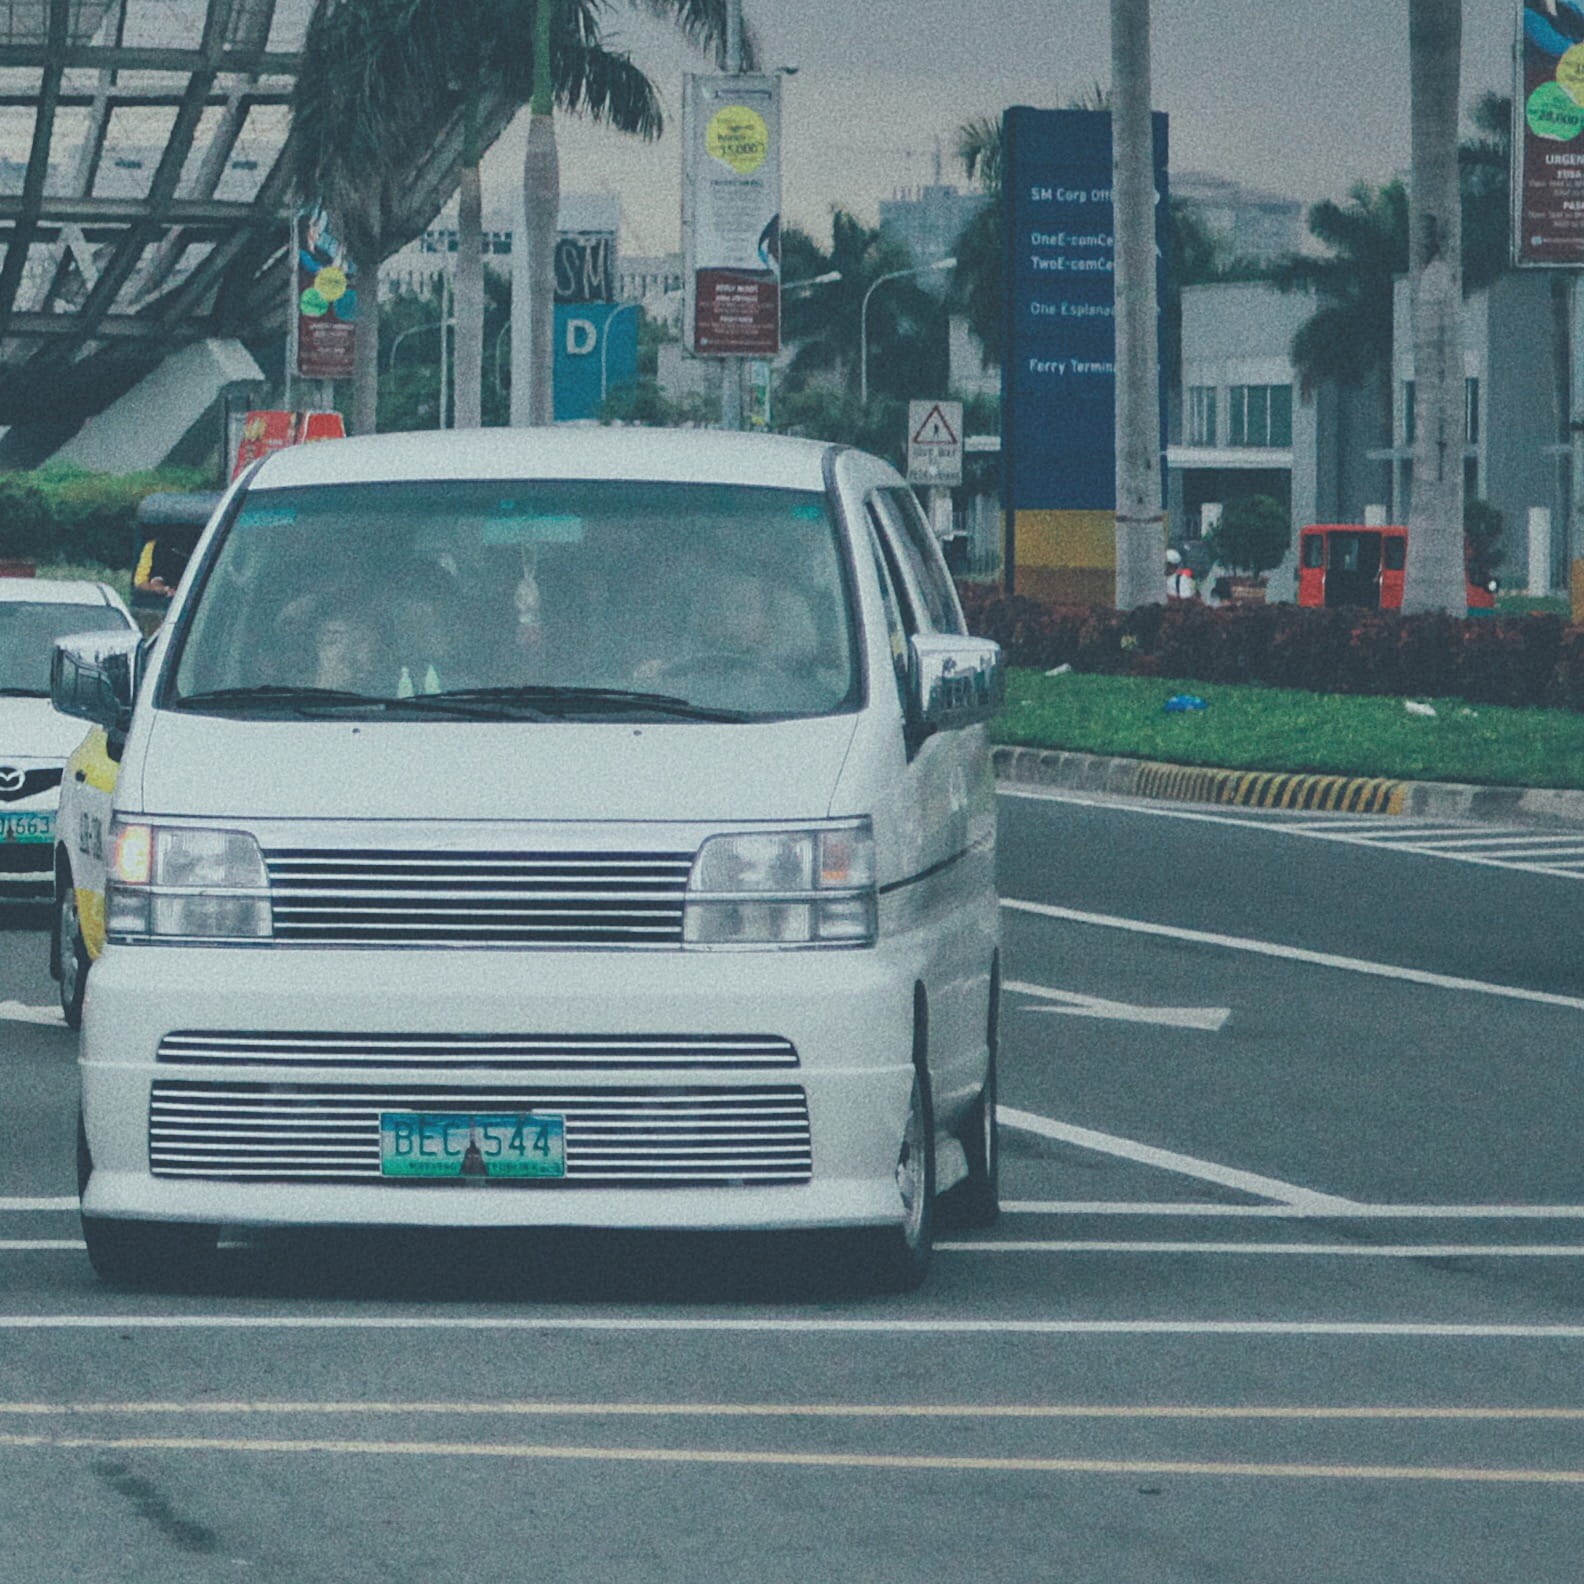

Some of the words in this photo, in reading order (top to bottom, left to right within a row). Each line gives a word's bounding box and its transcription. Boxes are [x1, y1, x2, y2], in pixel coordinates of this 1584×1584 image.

[1032, 188, 1052, 200] SM
[556, 238, 607, 301] SM
[1031, 302, 1055, 314] One
[566, 319, 597, 354] D
[1029, 359, 1066, 375] Ferry
[394, 1116, 461, 1157] BEC
[483, 1116, 551, 1157] 544
